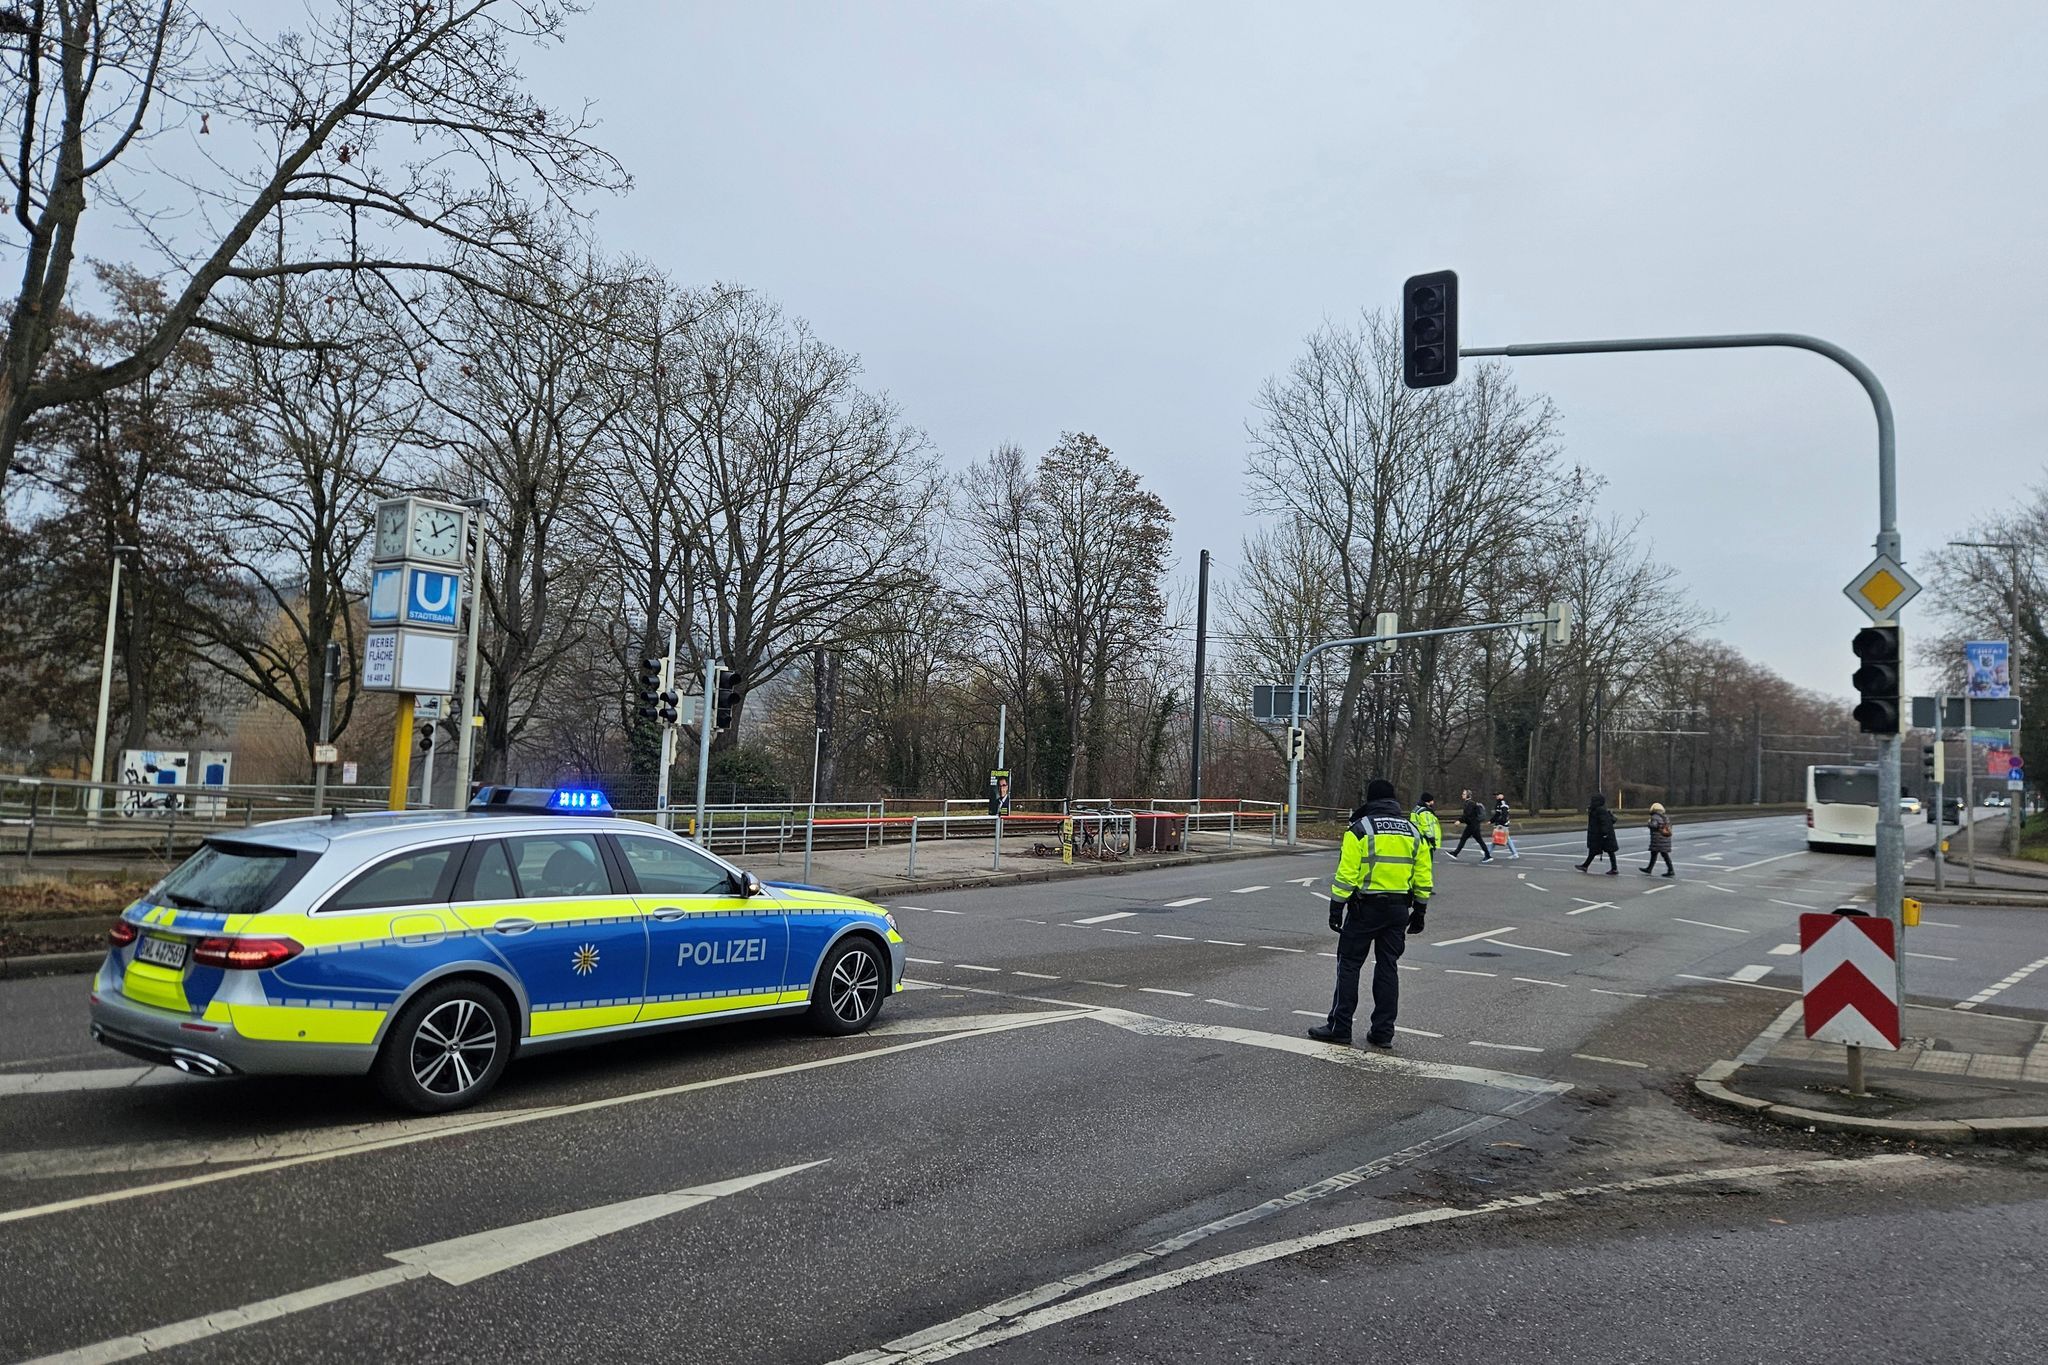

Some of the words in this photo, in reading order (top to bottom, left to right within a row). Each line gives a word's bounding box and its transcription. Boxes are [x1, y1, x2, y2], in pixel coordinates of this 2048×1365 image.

[416, 572, 451, 612] U
[409, 610, 454, 622] STADTBAHN
[370, 637, 394, 648] WERBE
[1376, 821, 1409, 831] POLIZEI
[677, 938, 767, 967] POLIZEI
